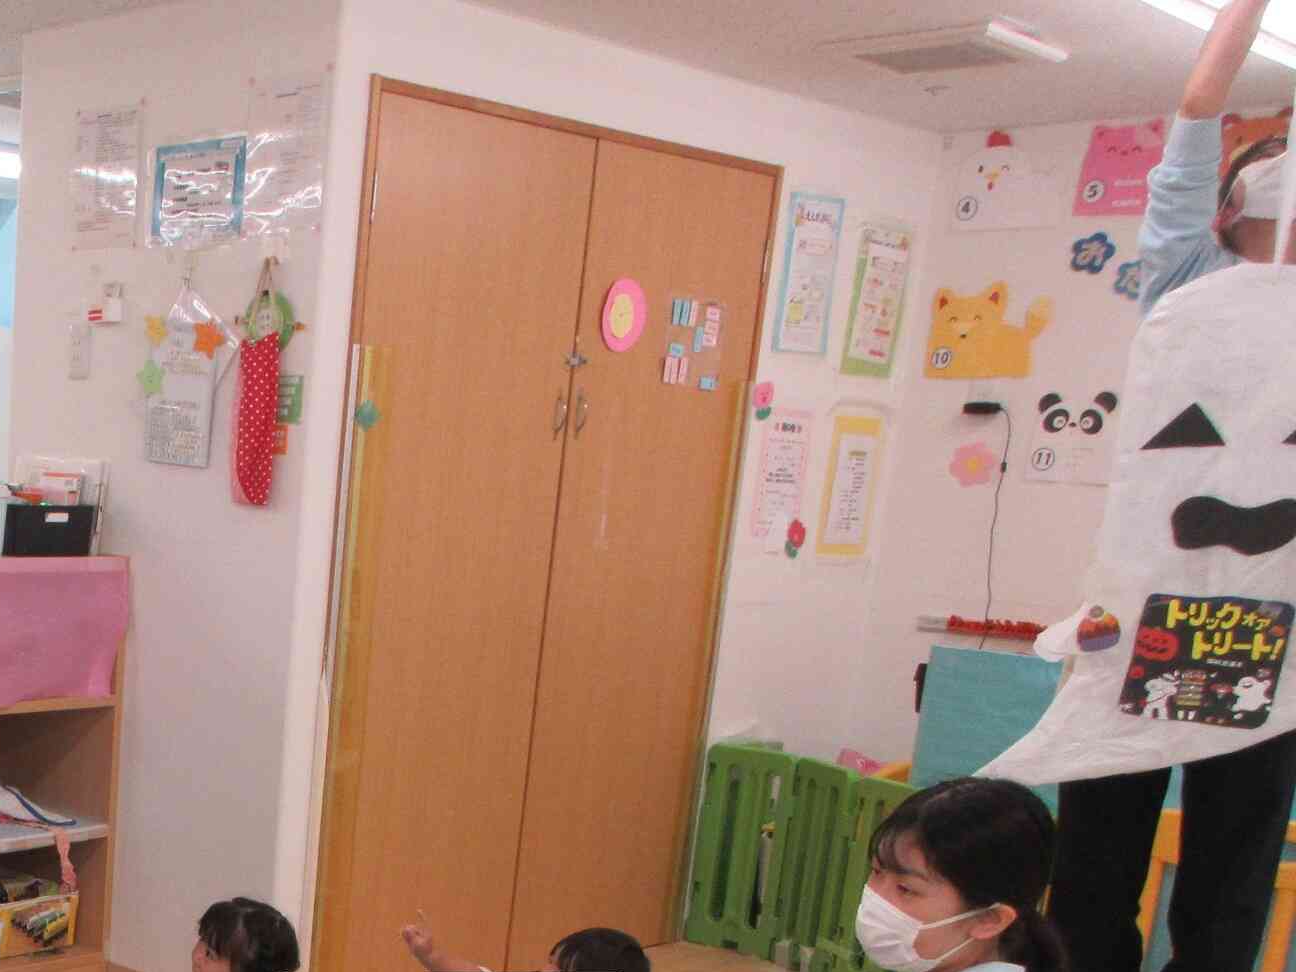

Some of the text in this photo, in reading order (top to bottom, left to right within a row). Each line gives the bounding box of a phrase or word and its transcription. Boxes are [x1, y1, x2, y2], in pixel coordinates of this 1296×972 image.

[934, 351, 950, 365] 10
[1035, 451, 1052, 466] 11
[1166, 598, 1273, 631] トリックオア
